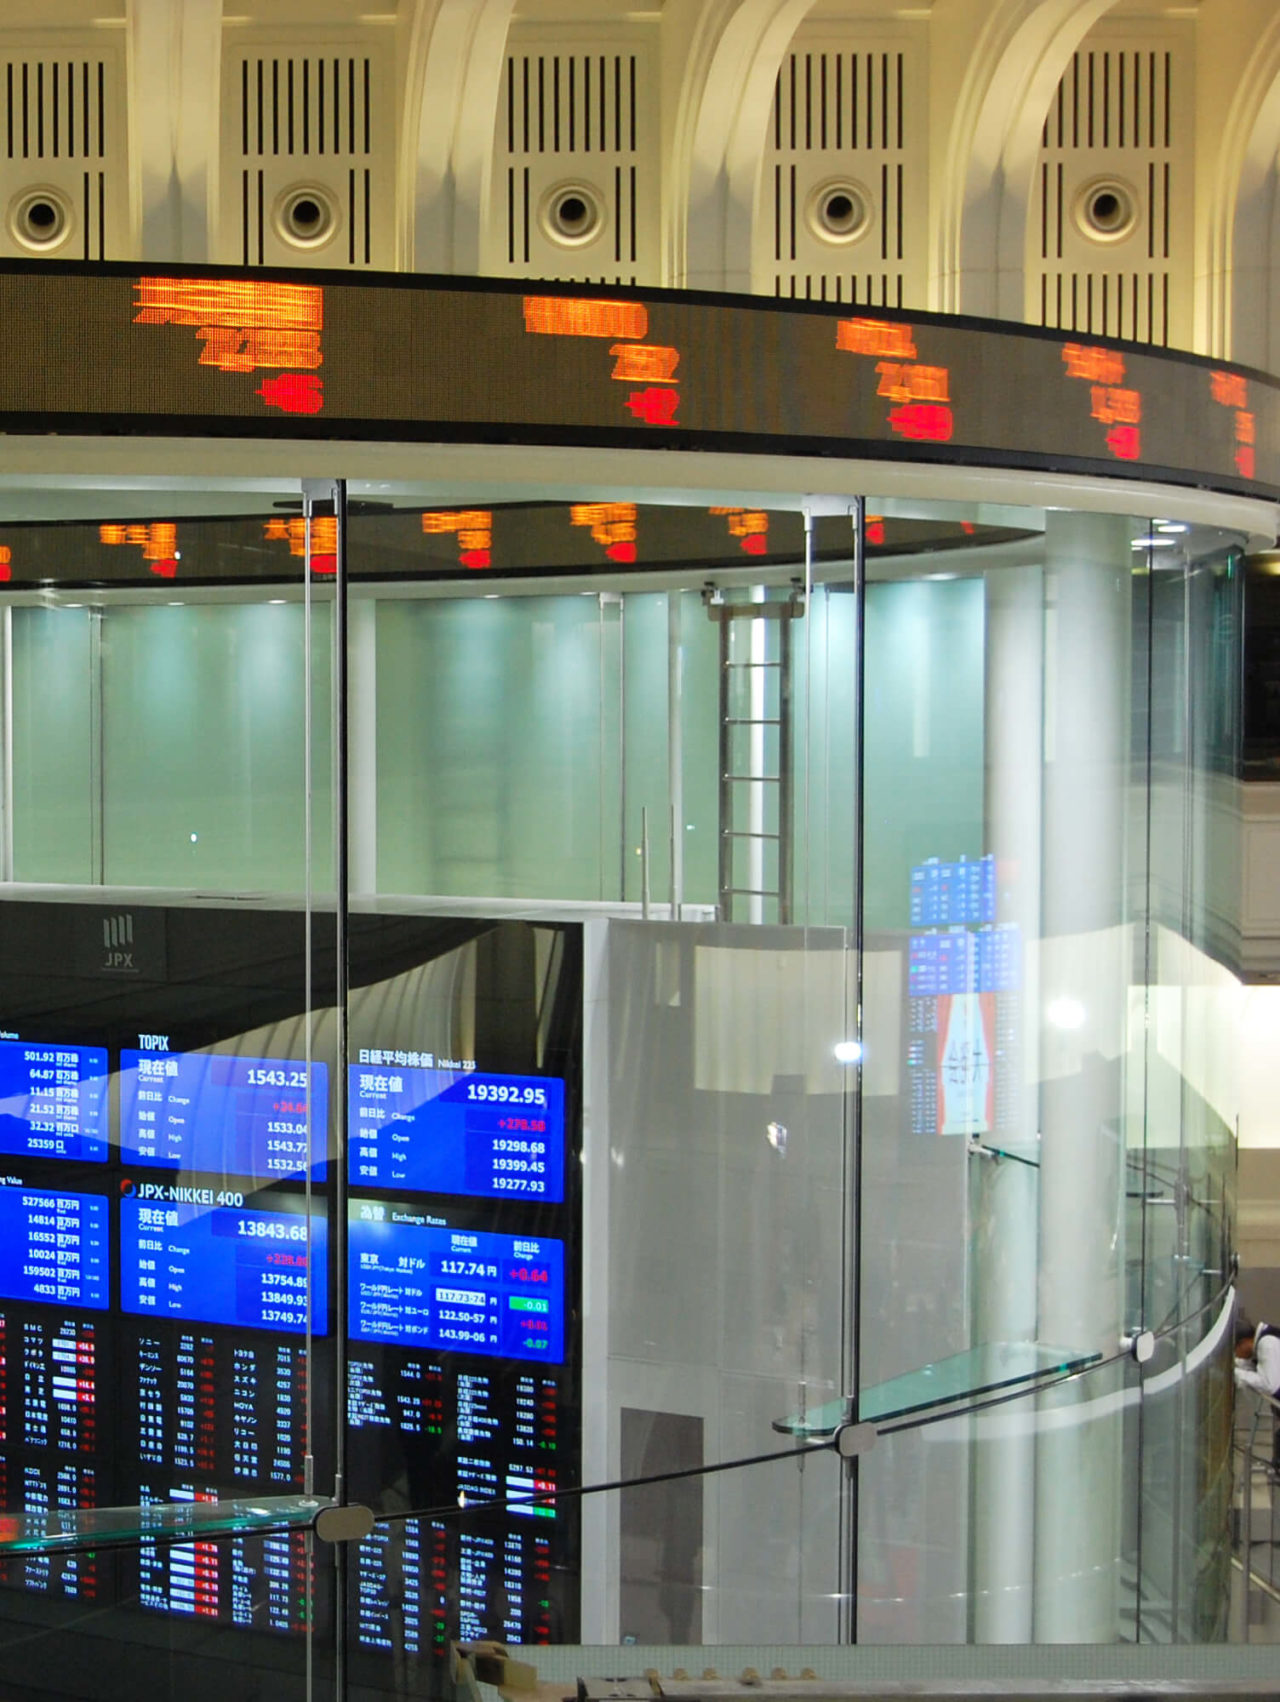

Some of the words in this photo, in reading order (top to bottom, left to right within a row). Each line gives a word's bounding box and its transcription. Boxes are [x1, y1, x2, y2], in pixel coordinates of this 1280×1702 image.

[105, 952, 133, 967] JPX
[138, 1034, 169, 1051] TOPIX
[24, 1051, 54, 1062] 501.92
[359, 1050, 433, 1067] 日経平均株価
[438, 1060, 461, 1069] Nikkei
[30, 1069, 54, 1079] 64.87
[138, 1060, 178, 1076] 現在値
[248, 1069, 307, 1087] 1543.25
[30, 1087, 54, 1096] 11.15
[360, 1074, 402, 1092] 現在値
[468, 1085, 545, 1104] 19392.95
[30, 1104, 54, 1114] 21.52
[30, 1122, 54, 1131] 32.32
[28, 1138, 54, 1149] 25359
[392, 1134, 410, 1142] Open
[493, 1140, 545, 1154] 19298.68
[169, 1152, 181, 1160] Low
[392, 1153, 406, 1161] High
[493, 1159, 544, 1172] 19399.45
[360, 1166, 378, 1176] 安値
[492, 1178, 544, 1192] 19277.93
[138, 1184, 213, 1204] JPX-NIKKEI
[217, 1191, 243, 1207] 400
[23, 1196, 55, 1208] 527566
[28, 1214, 55, 1225] 14814
[139, 1208, 178, 1226] 現在値
[238, 1221, 307, 1241] 13843.68
[392, 1213, 425, 1225] Exchange
[28, 1232, 55, 1243] 16552
[451, 1234, 477, 1247] 現在値
[29, 1249, 55, 1260] 10024
[24, 1266, 55, 1277] 159502
[169, 1266, 184, 1274] Open
[399, 1257, 425, 1268] 対ドル
[441, 1260, 485, 1276] 117.74
[487, 1266, 496, 1277] 円
[510, 1269, 548, 1282] +0.64
[34, 1284, 55, 1295] 4833
[139, 1295, 156, 1305] 安値
[439, 1292, 485, 1304] 117.73-74
[524, 1301, 547, 1311] -0.01
[439, 1311, 485, 1323] 122.50-57
[439, 1329, 485, 1342] 143.99-06
[523, 1339, 548, 1349] -0.07
